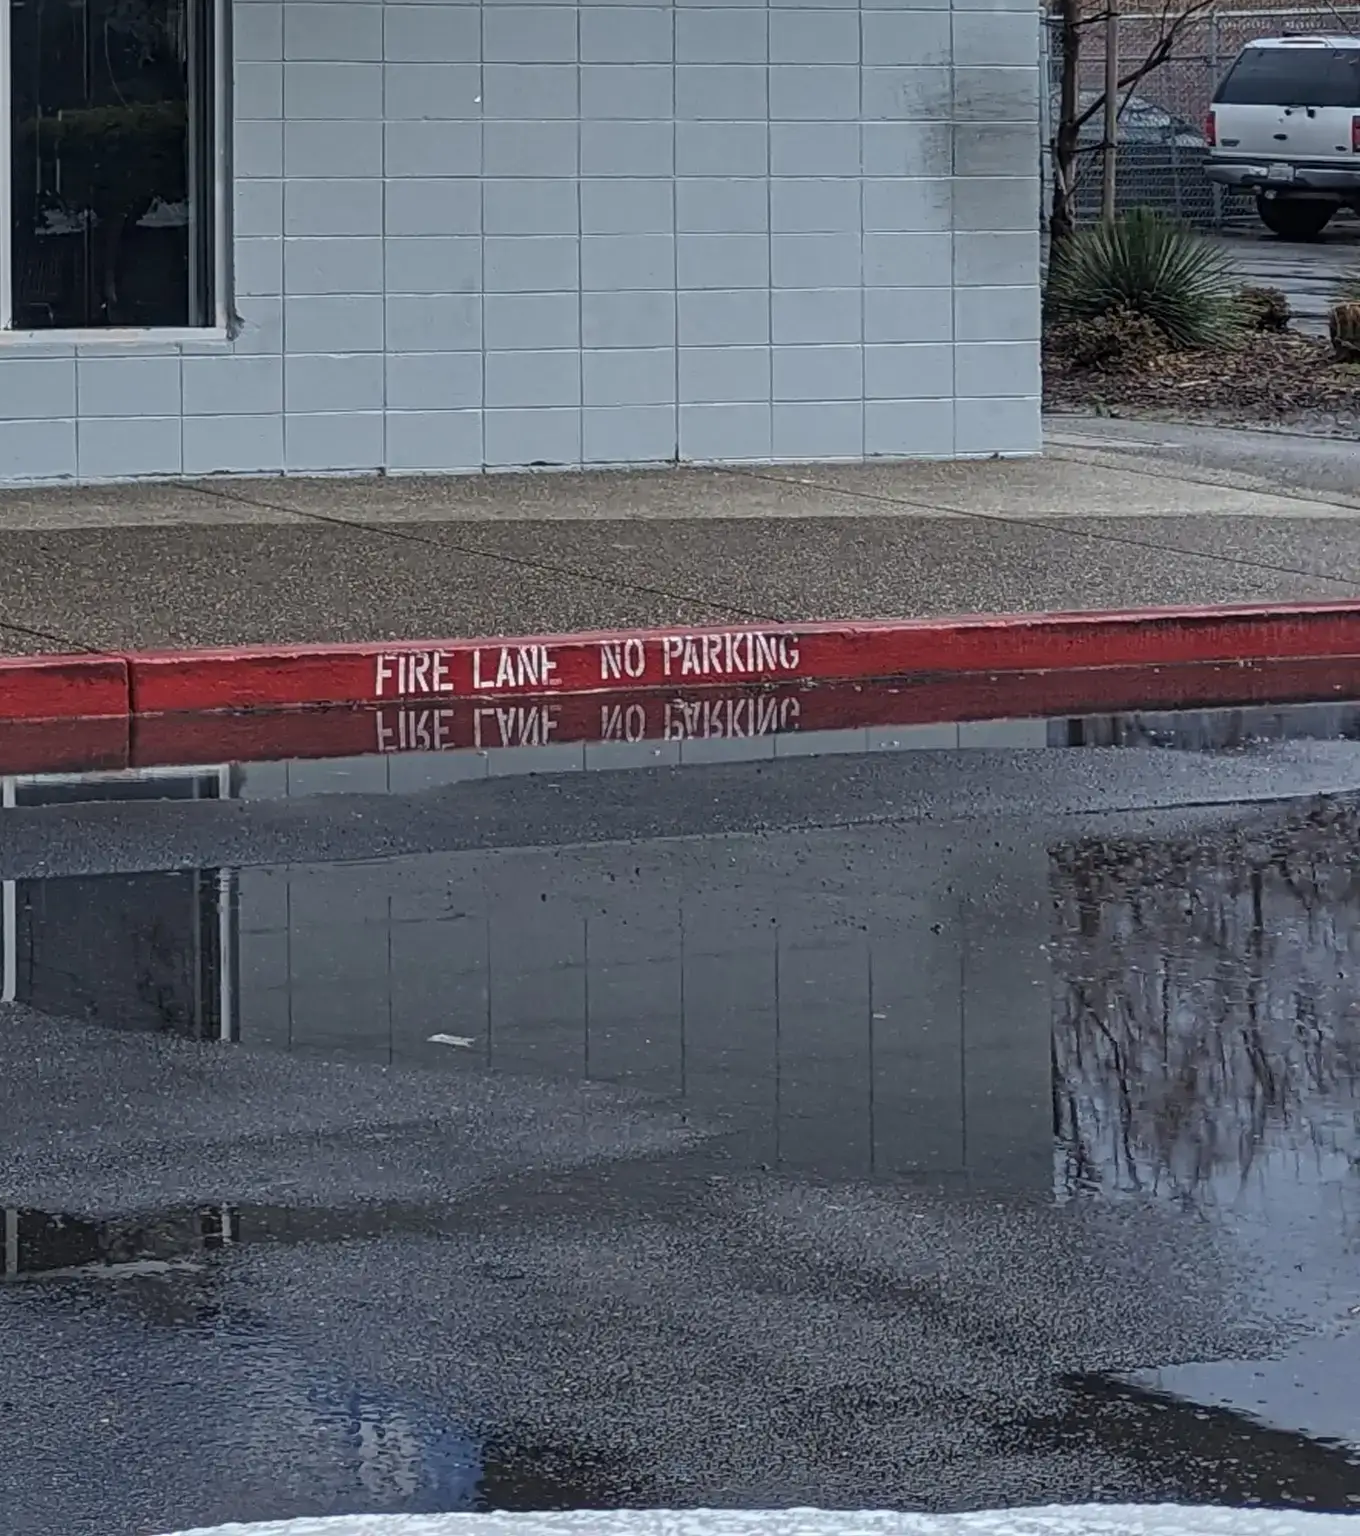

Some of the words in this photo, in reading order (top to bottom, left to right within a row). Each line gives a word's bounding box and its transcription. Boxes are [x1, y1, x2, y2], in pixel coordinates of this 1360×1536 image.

[376, 648, 455, 695] FIRE
[473, 645, 563, 689] LANE
[600, 639, 646, 679] NO
[662, 632, 800, 676] PARKING
